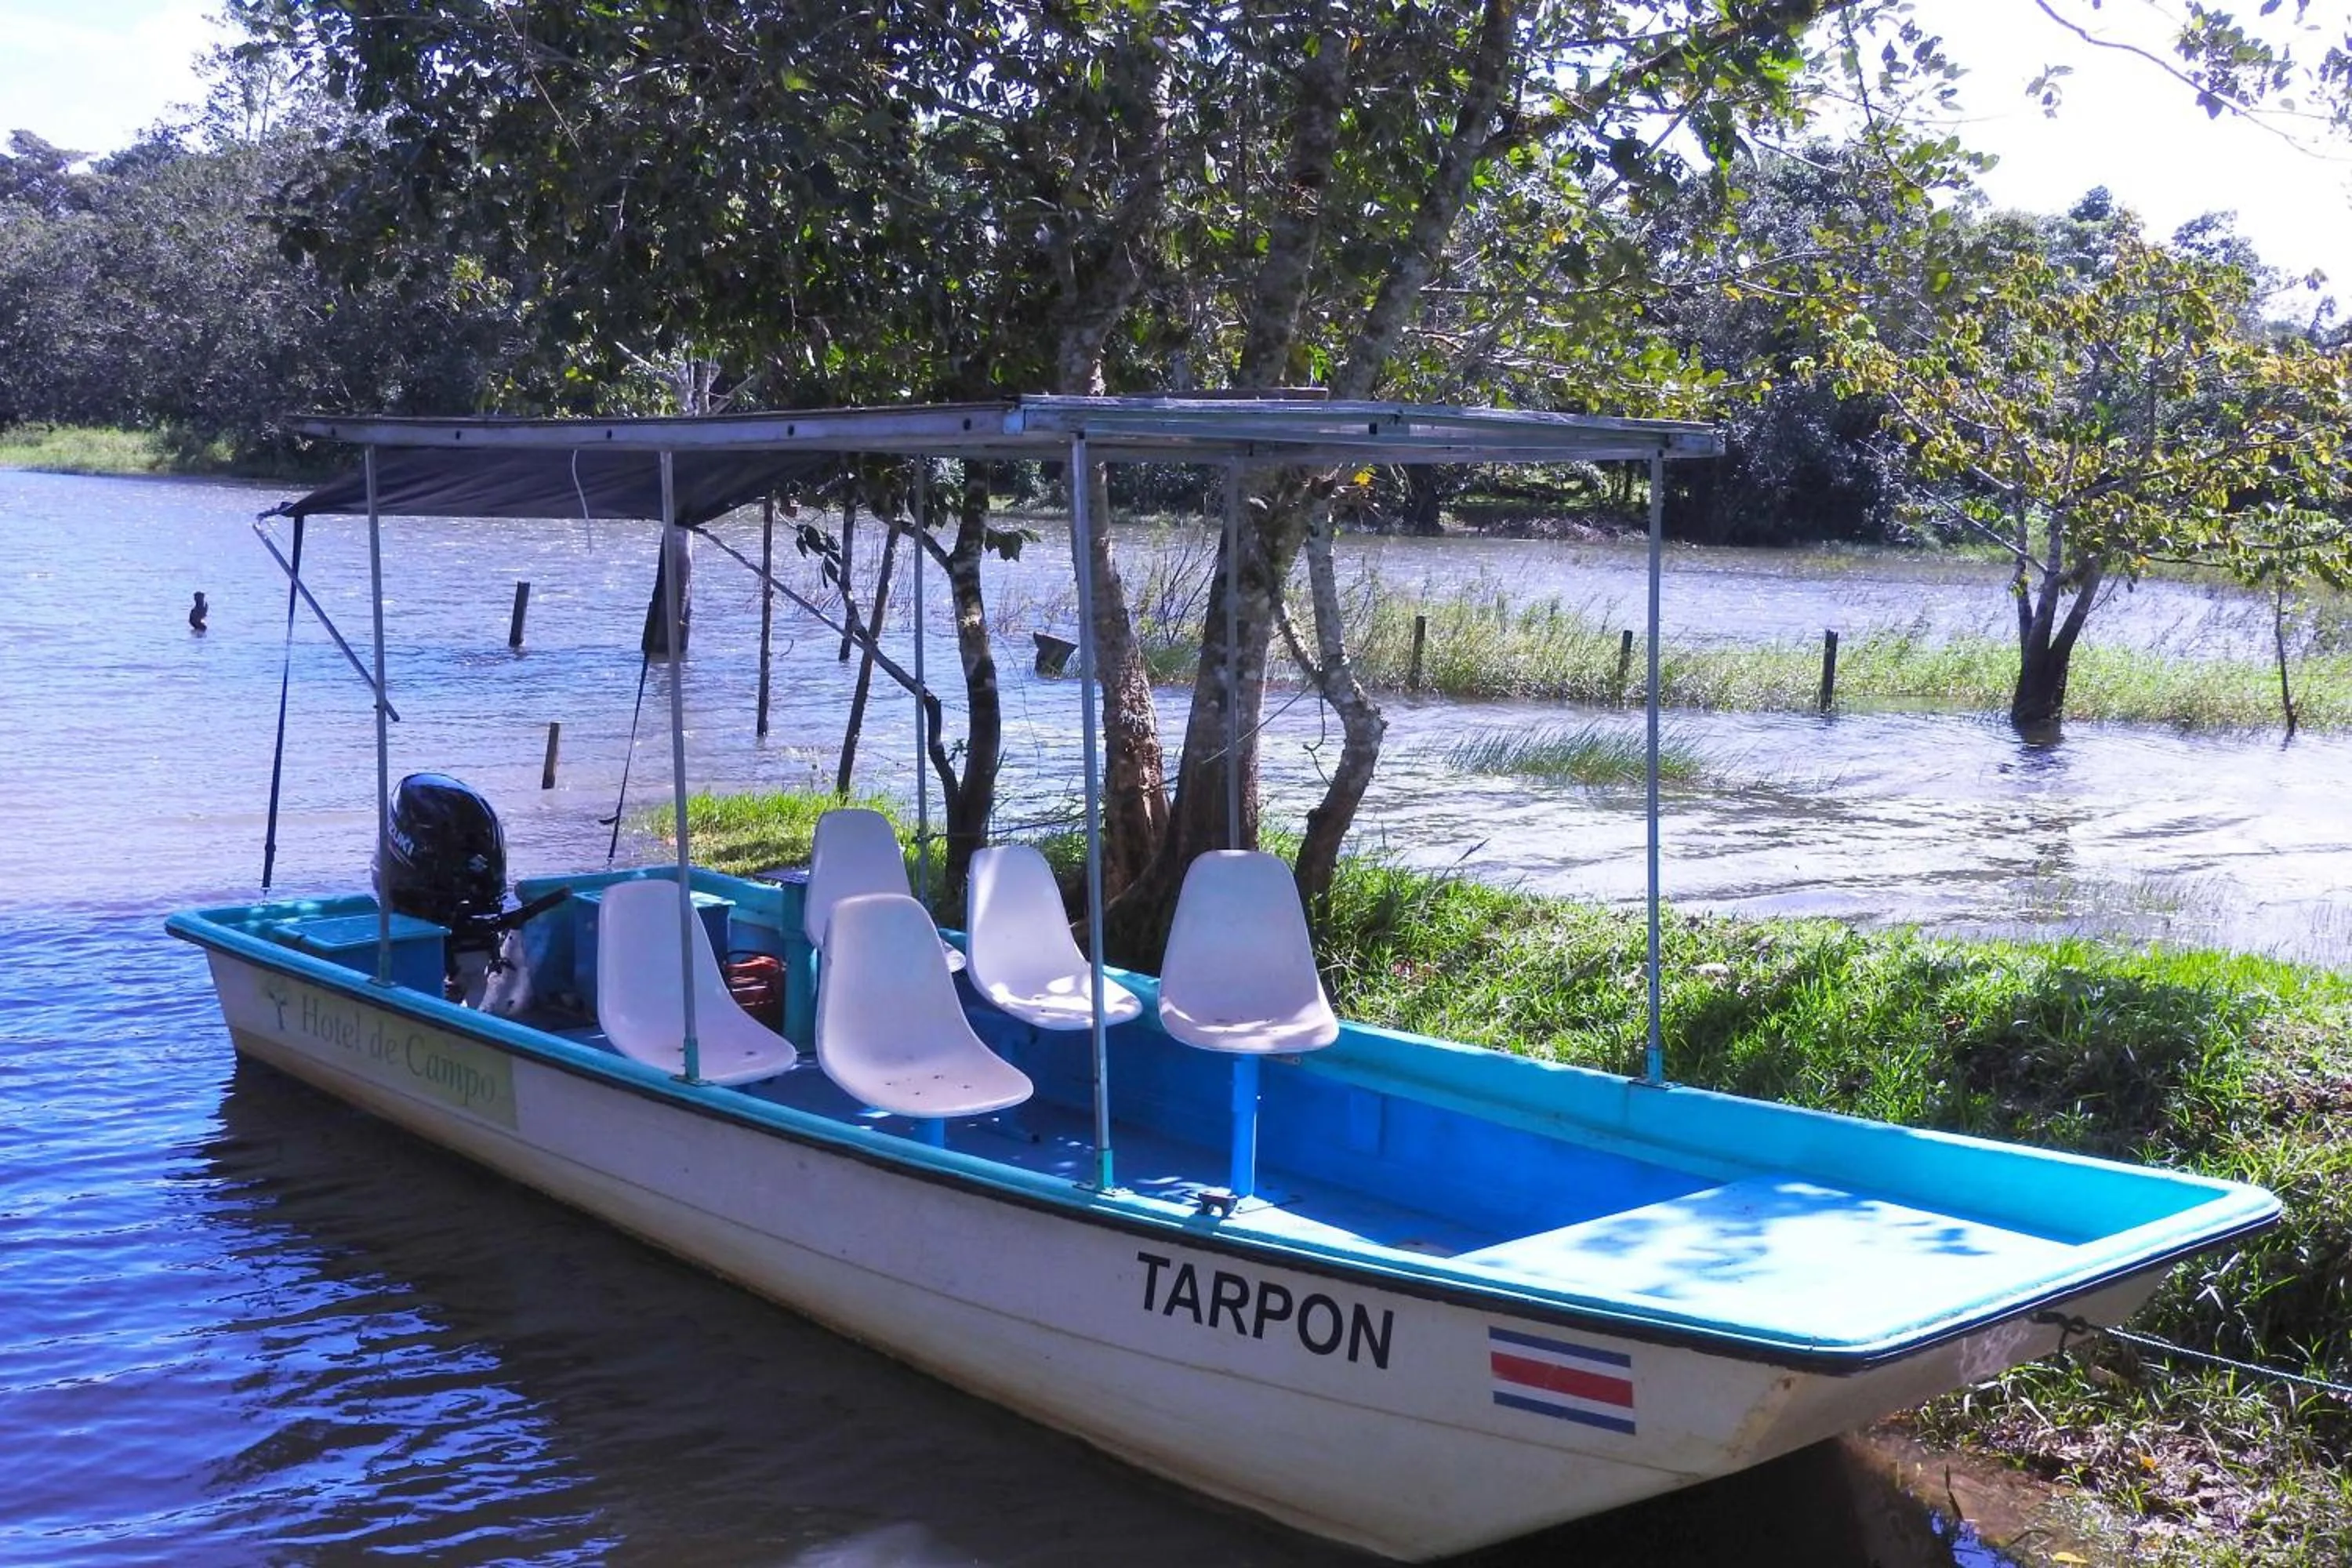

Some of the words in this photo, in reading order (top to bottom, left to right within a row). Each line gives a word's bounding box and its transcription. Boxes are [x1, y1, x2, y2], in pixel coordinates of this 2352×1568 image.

[302, 994, 361, 1051] Hotel
[369, 1025, 399, 1064] de
[405, 1033, 496, 1105] Campo
[1137, 1251, 1394, 1370] TARPON
